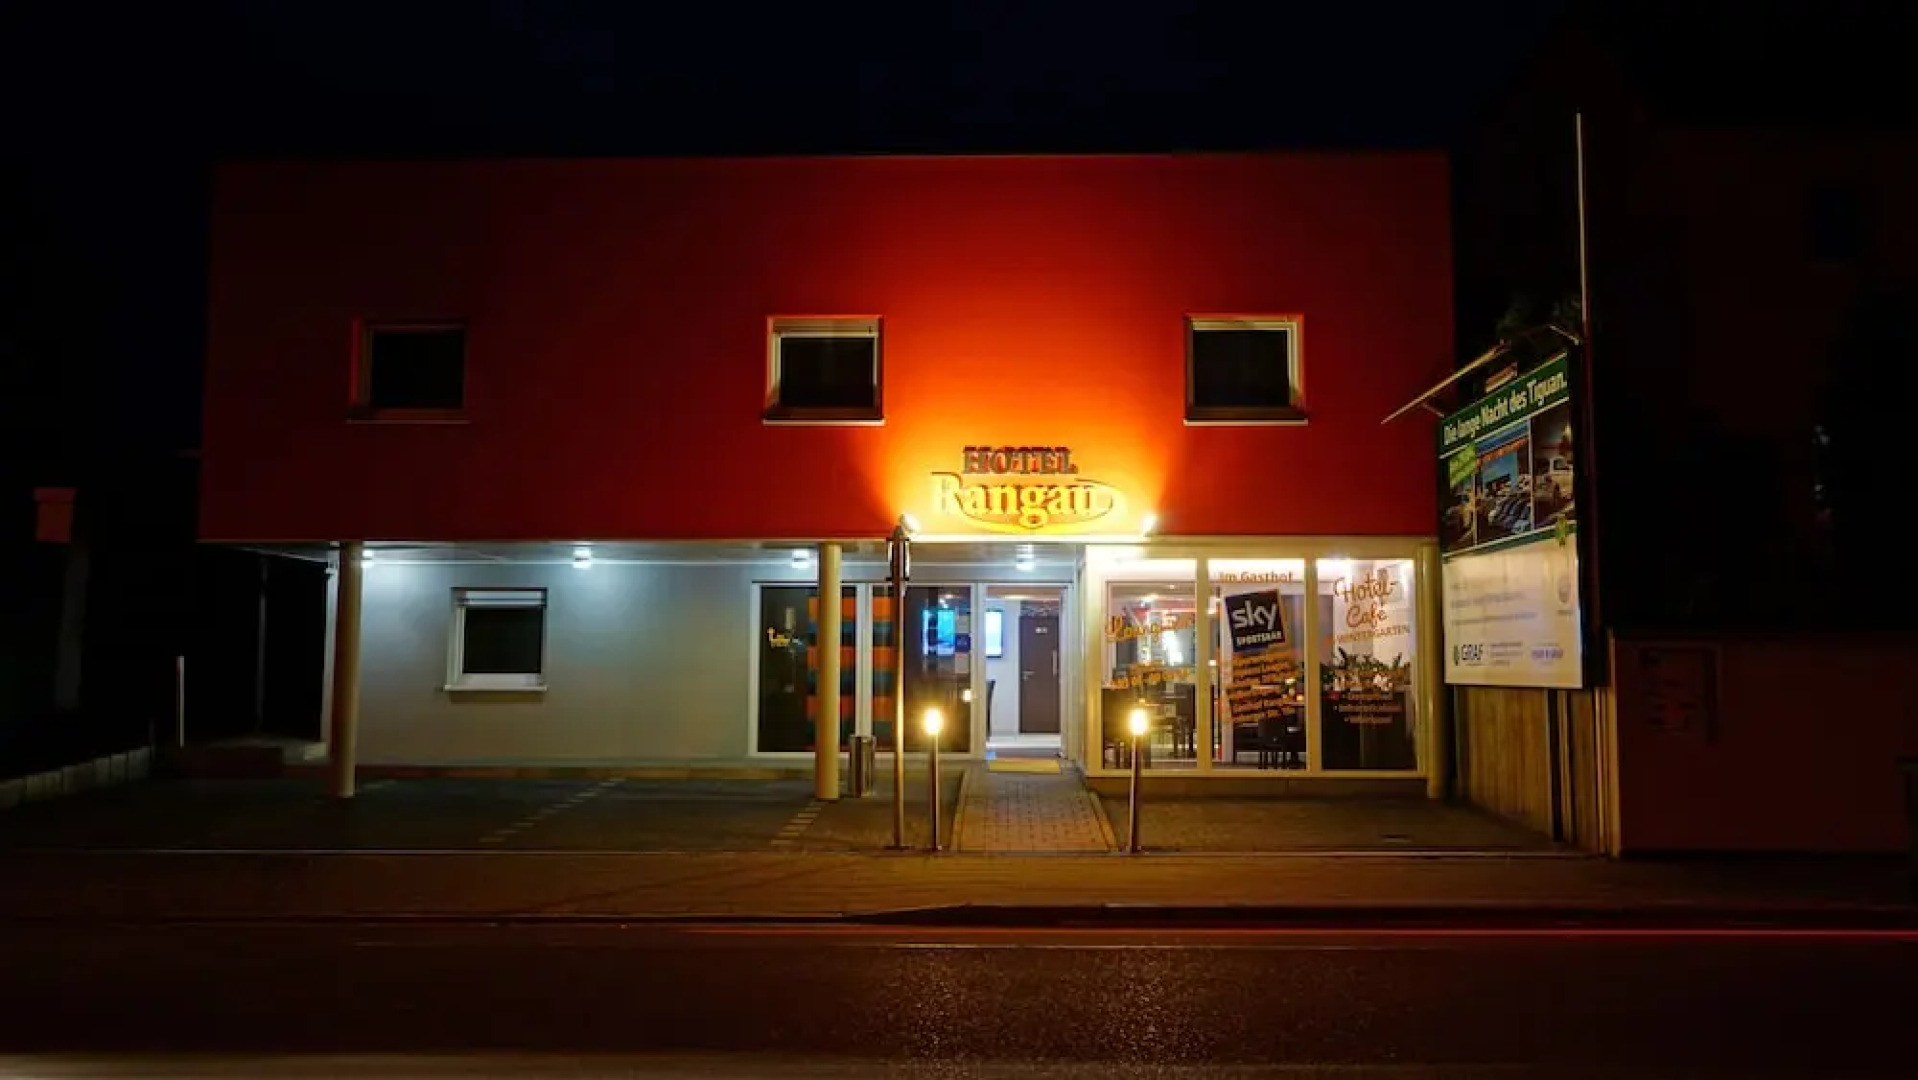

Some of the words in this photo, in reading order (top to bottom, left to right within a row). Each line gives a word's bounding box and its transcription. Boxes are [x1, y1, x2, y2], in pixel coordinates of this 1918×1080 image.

[1443, 423, 1457, 445] Die
[1457, 416, 1480, 439] lange
[1481, 397, 1508, 428] Nacht
[1509, 389, 1527, 413] des
[962, 446, 1078, 474] HOTEL
[931, 471, 1104, 529] Rangau
[1240, 570, 1293, 583] Gasthof
[1232, 600, 1277, 630] sky
[1461, 643, 1484, 661] GRAF
